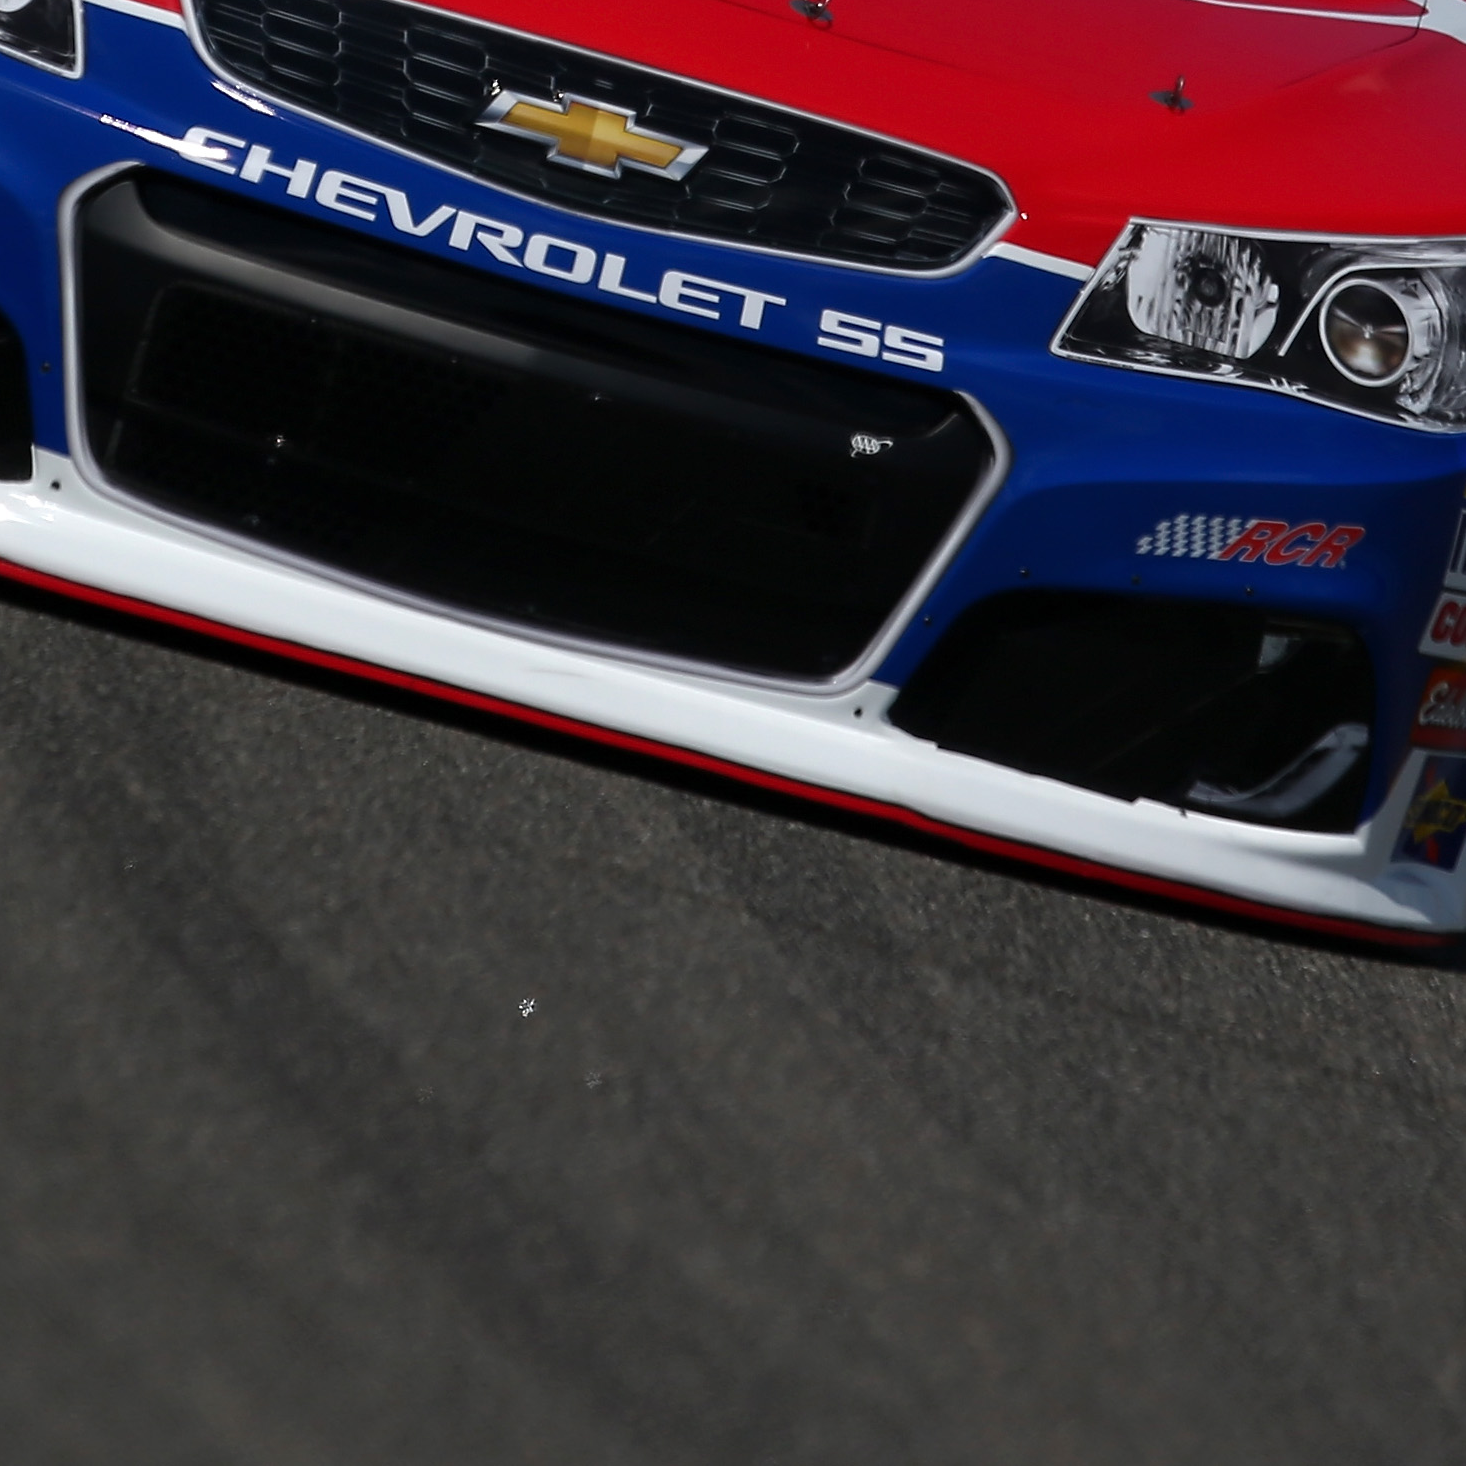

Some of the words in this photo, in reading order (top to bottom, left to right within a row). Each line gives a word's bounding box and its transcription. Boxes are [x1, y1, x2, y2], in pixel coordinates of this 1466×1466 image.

[179, 125, 787, 332] CHEVROLET
[817, 308, 945, 373] SS
[1217, 519, 1366, 569] RCR
